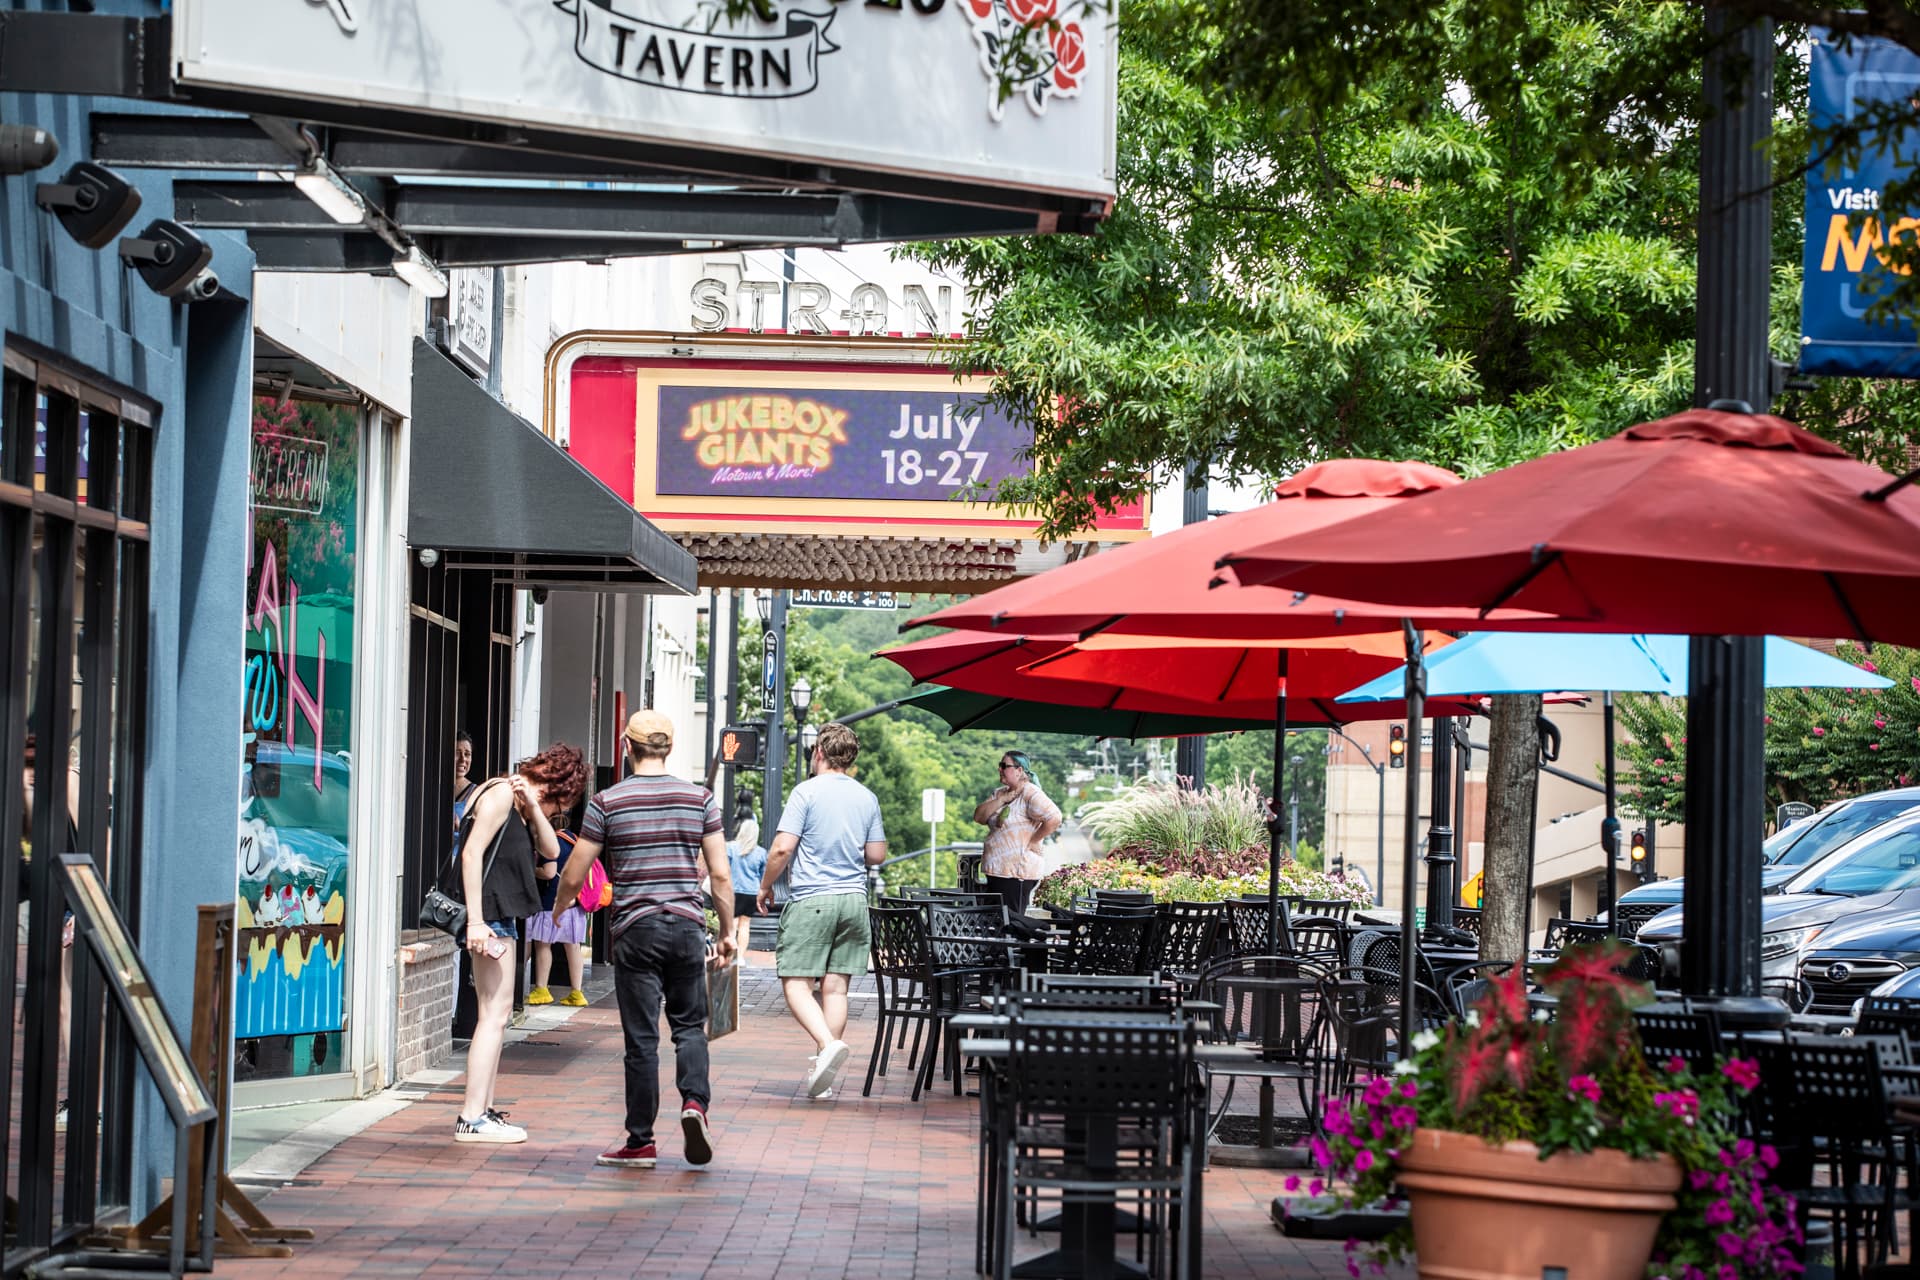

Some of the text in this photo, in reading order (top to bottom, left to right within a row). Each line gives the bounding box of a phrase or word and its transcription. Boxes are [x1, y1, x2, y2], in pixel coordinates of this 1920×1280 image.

[609, 24, 792, 88] TAVERN
[1827, 187, 1880, 210] Visit
[683, 396, 848, 442] JUKEBOX
[888, 403, 982, 451] July
[698, 432, 832, 468] GIANTS
[881, 449, 989, 487] 18-27
[250, 444, 325, 504] ICE CREAM
[711, 466, 763, 484] Motown
[775, 463, 817, 481] More!
[878, 598, 894, 608] 100
